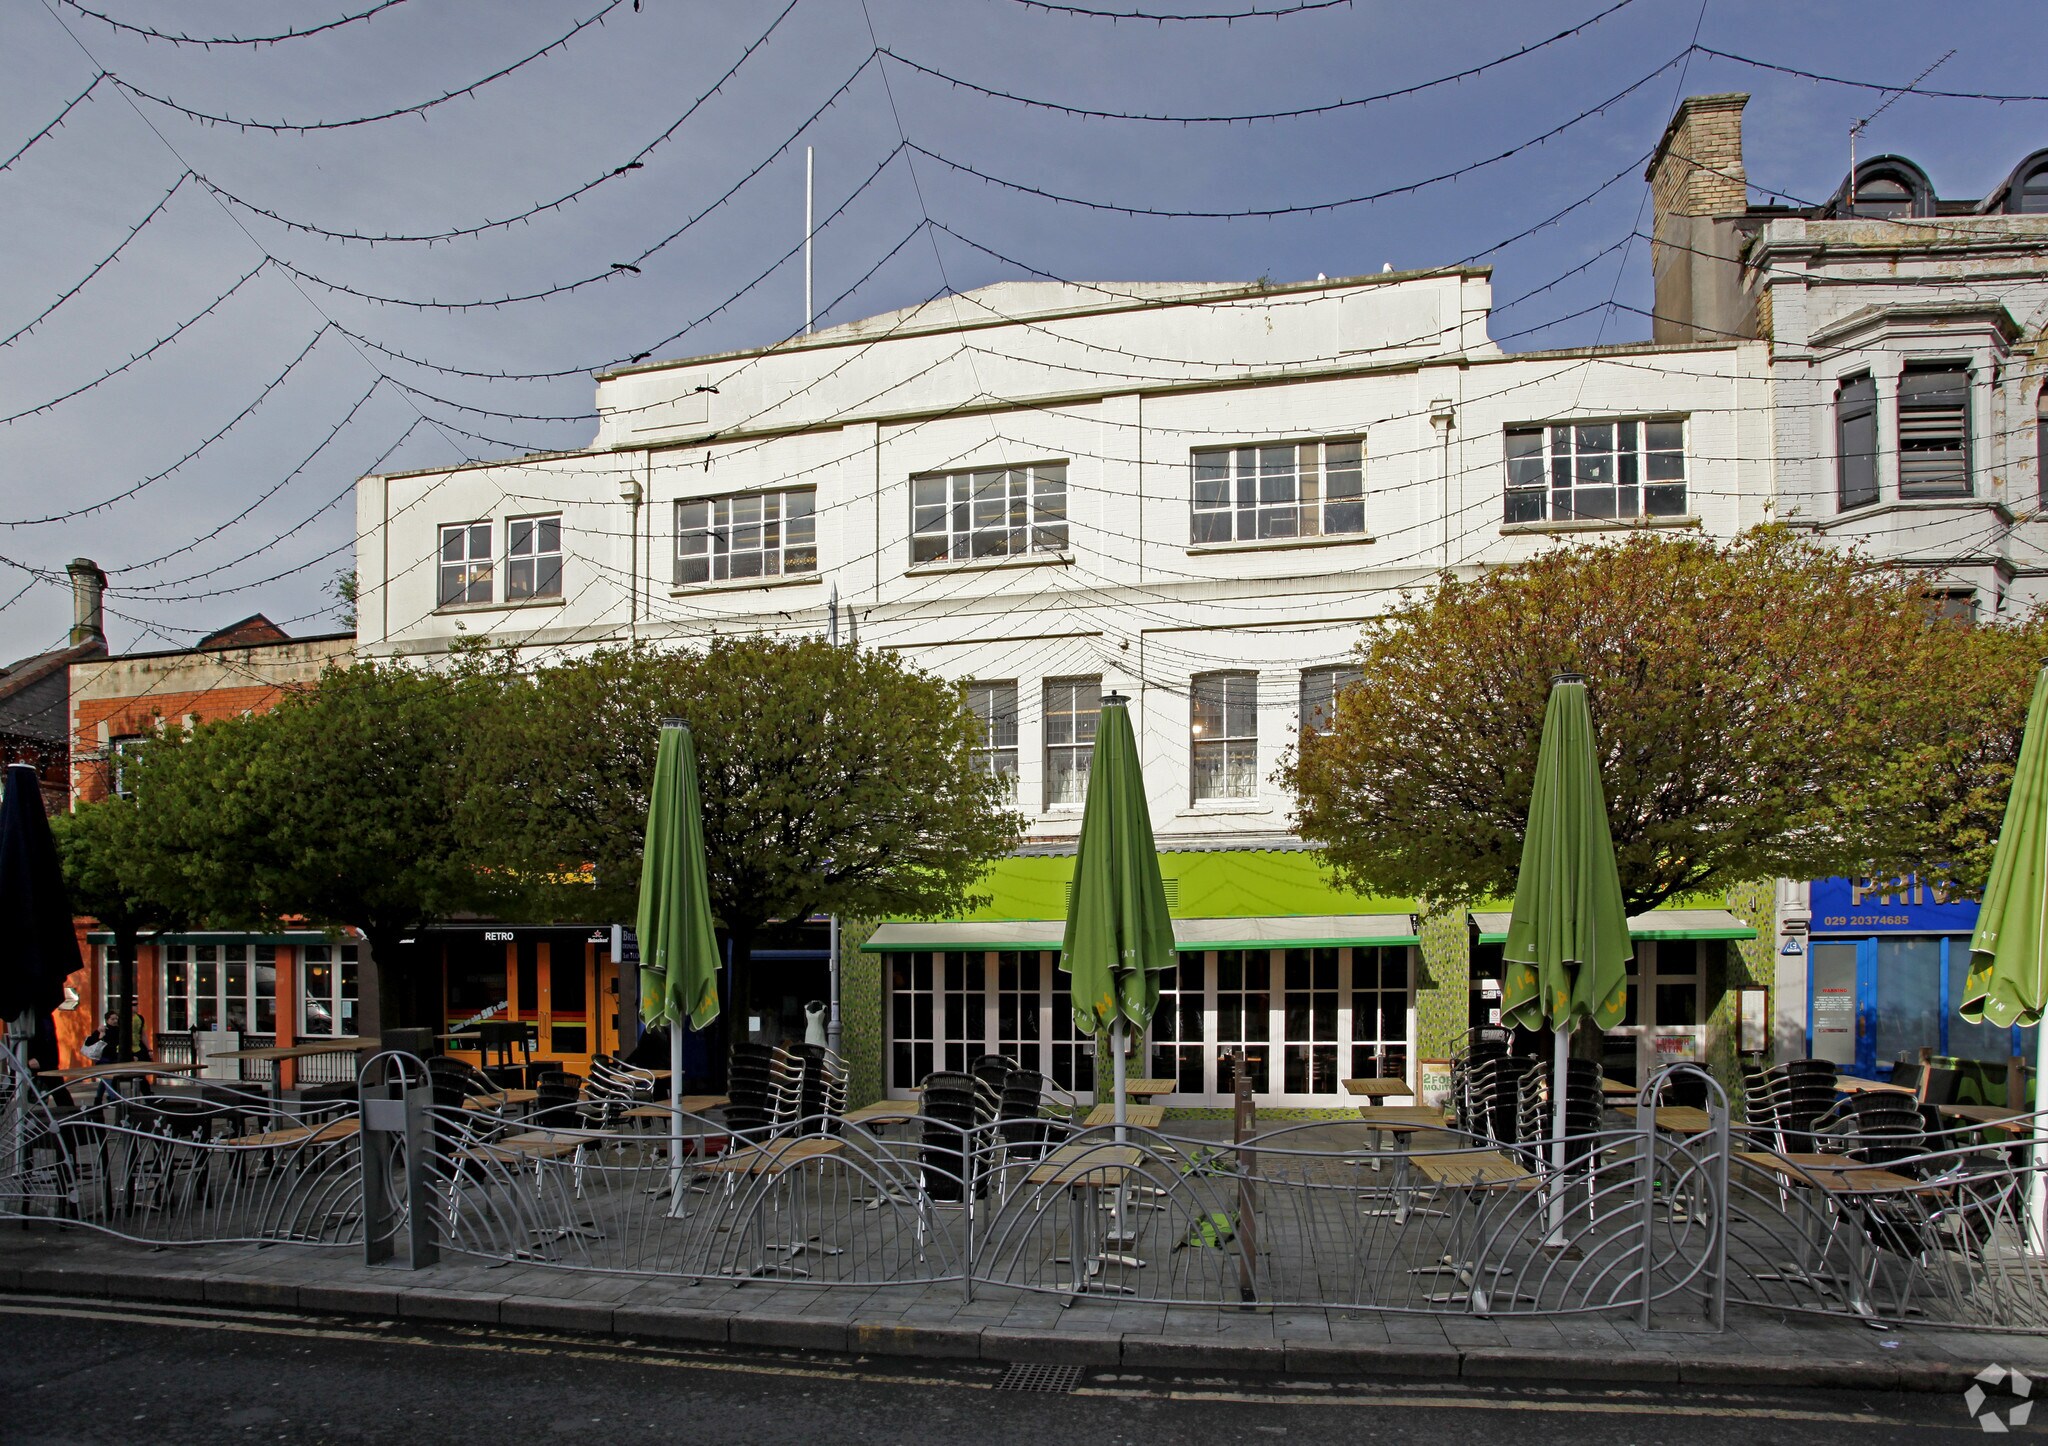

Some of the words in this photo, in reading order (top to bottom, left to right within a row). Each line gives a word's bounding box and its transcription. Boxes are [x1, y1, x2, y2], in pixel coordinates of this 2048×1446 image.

[1852, 867, 1982, 906] PRIV
[1824, 916, 1847, 926] 029
[1850, 915, 1909, 926] 20374685
[485, 932, 514, 941] RETRO
[1423, 1073, 1431, 1084] 2
